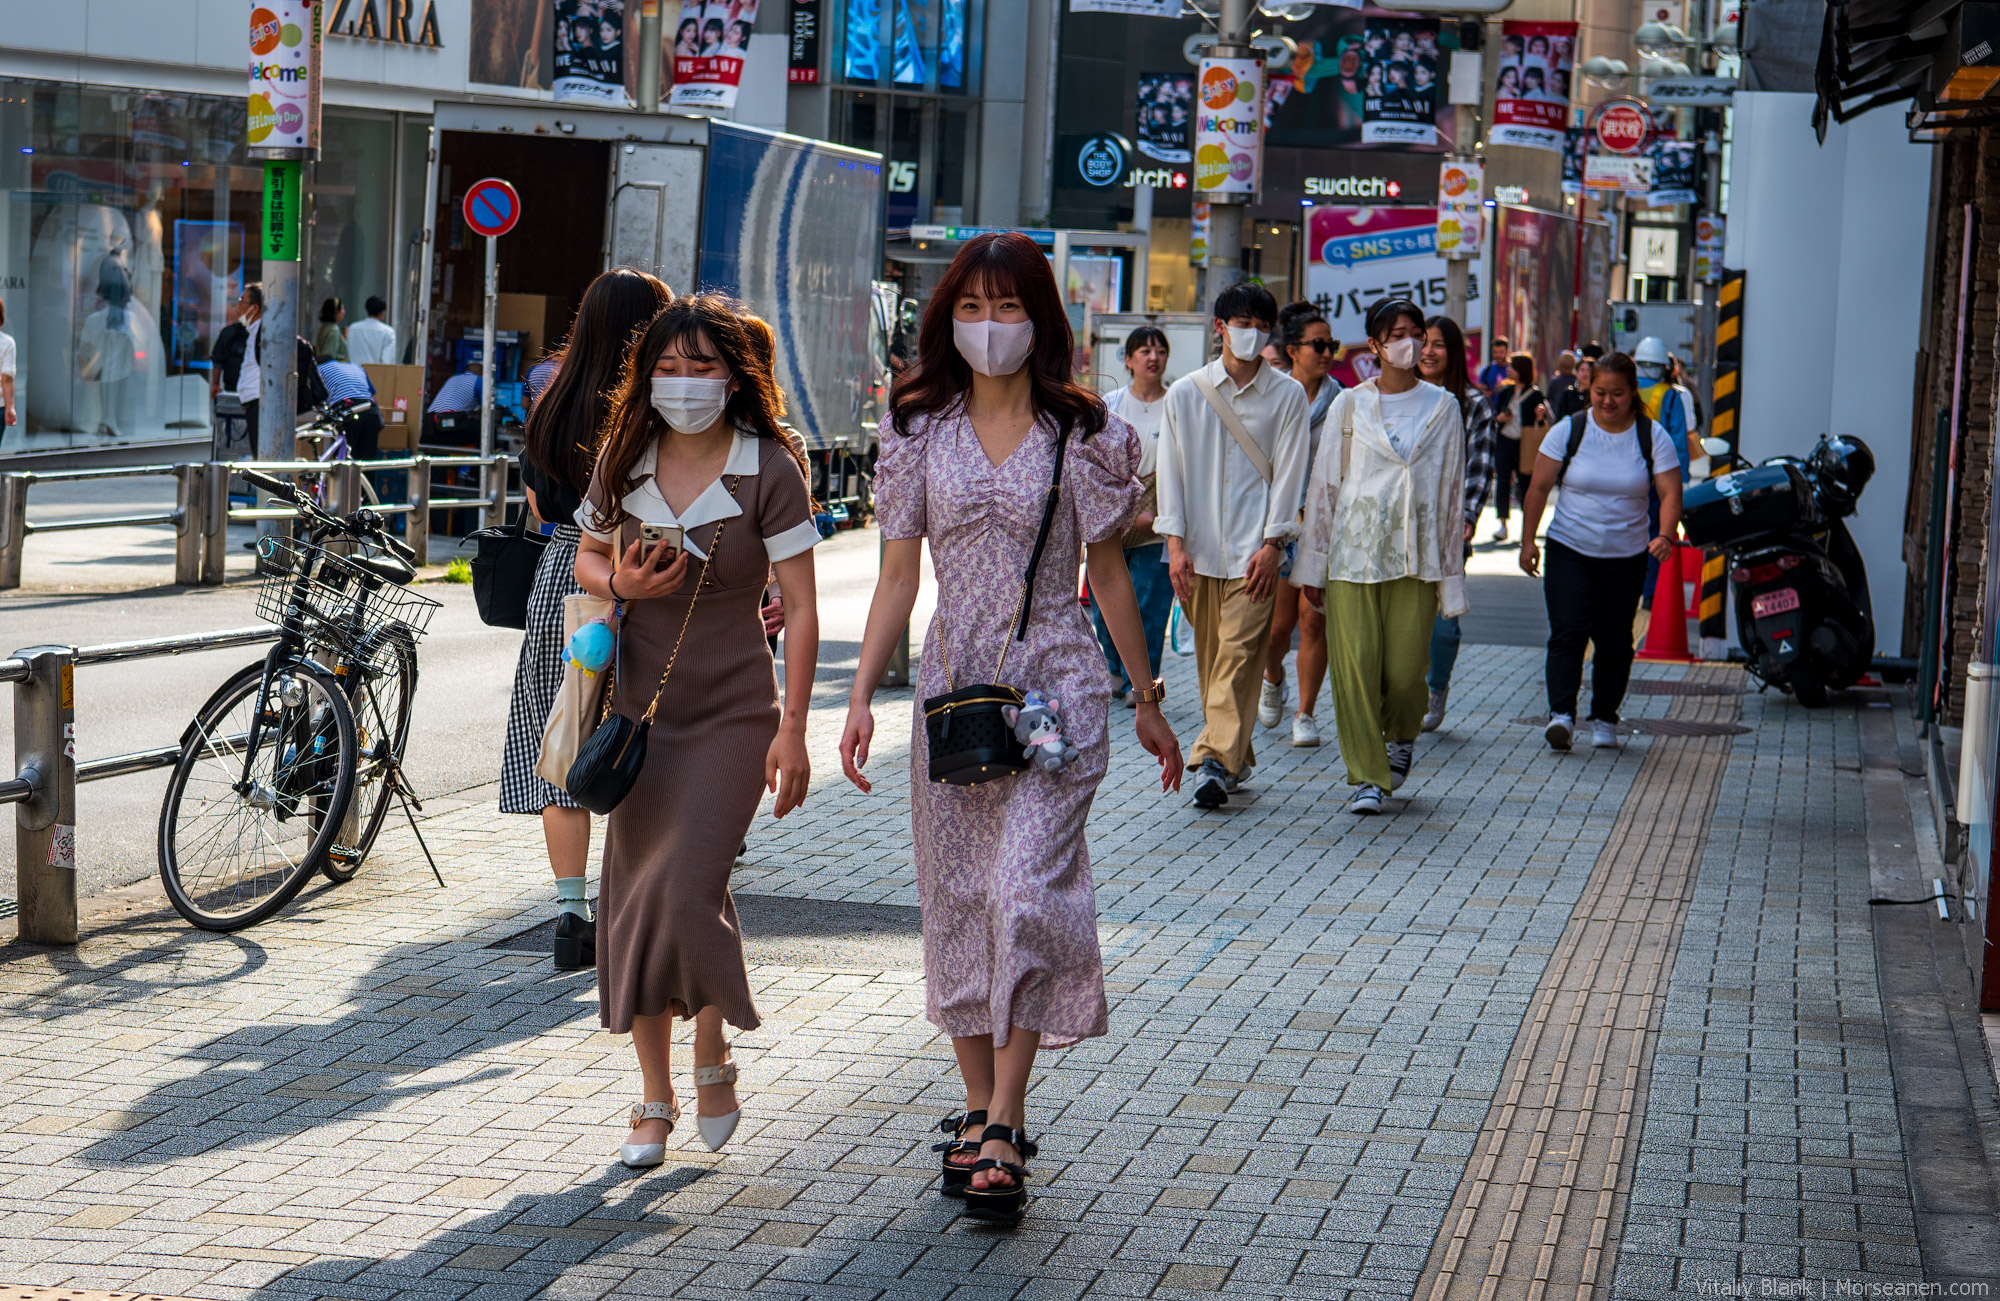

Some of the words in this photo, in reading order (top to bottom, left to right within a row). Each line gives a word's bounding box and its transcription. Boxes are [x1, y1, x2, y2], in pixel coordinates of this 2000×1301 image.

[249, 20, 278, 47] Enjoy
[325, 0, 445, 49] ZARA
[793, 11, 805, 60] HOUSE
[804, 11, 815, 39] ALE
[1202, 77, 1234, 102] Enjoy
[1198, 115, 1257, 134] Welcome
[1087, 158, 1113, 169] BODY
[1093, 151, 1108, 159] THE
[1087, 168, 1113, 178] SHOP
[1304, 175, 1387, 197] swatch
[270, 167, 286, 255] 客引きは犯罪です
[0, 276, 25, 289] ARA
